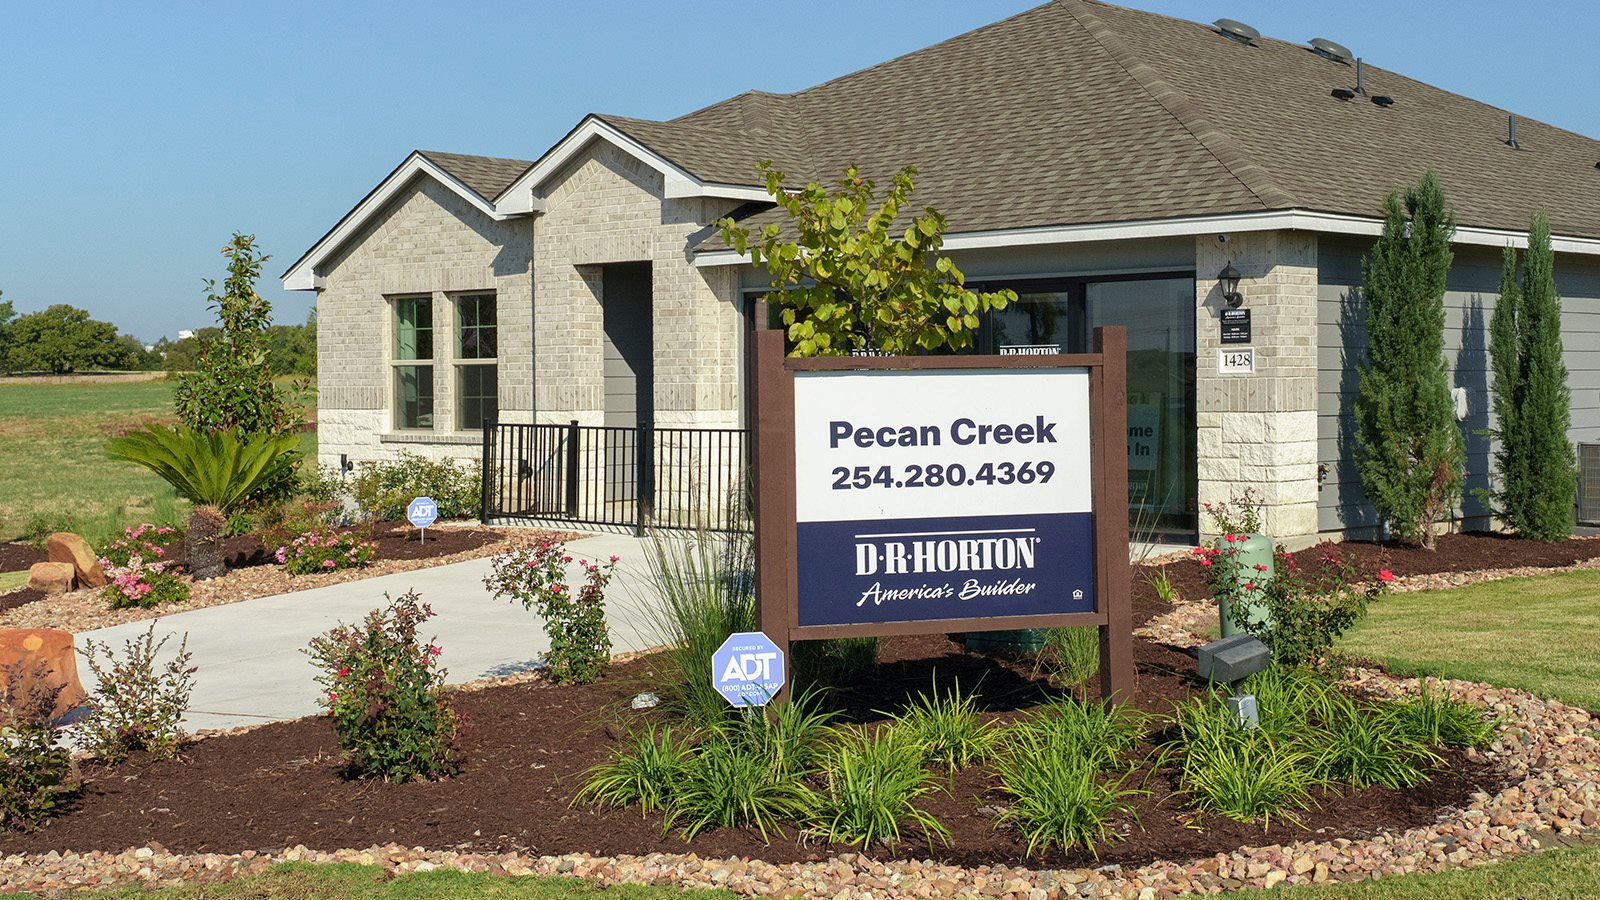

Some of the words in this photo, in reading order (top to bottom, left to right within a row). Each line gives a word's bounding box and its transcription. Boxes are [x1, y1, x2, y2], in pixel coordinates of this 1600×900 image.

[1224, 354, 1250, 366] 1428
[829, 421, 941, 448] Pecan
[950, 416, 1057, 444] Creek
[1135, 442, 1150, 456] In
[832, 461, 1055, 490] 254.280.4369
[411, 505, 434, 517] ADT
[856, 582, 954, 606] America's
[958, 578, 1036, 600] Builder
[720, 652, 776, 682] ADT
